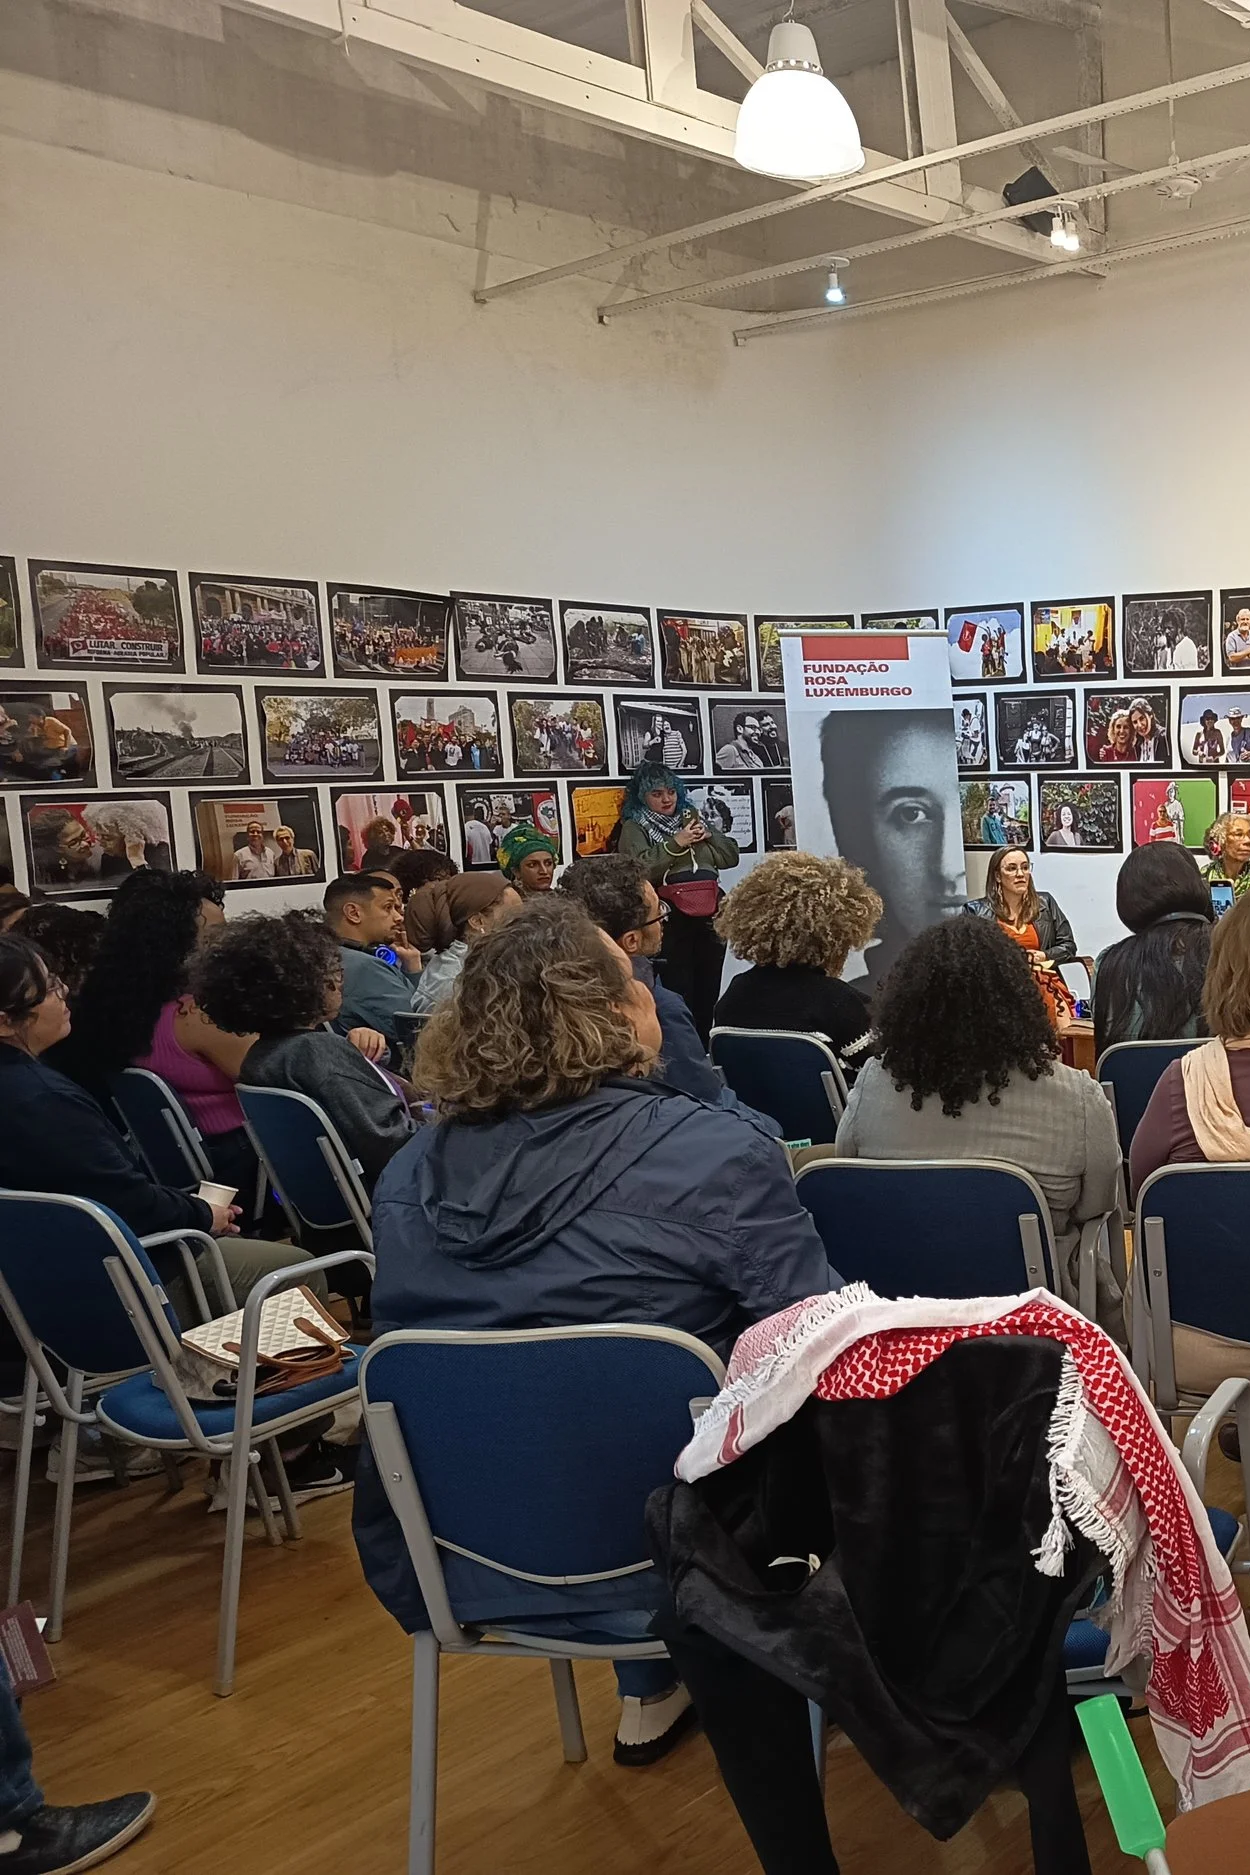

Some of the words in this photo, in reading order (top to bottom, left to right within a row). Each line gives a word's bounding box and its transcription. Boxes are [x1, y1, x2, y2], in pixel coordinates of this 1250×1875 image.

[803, 661, 889, 675] FUNDAÇÃO
[804, 676, 849, 685] ROSA
[805, 686, 912, 698] LUXEMBURGO
